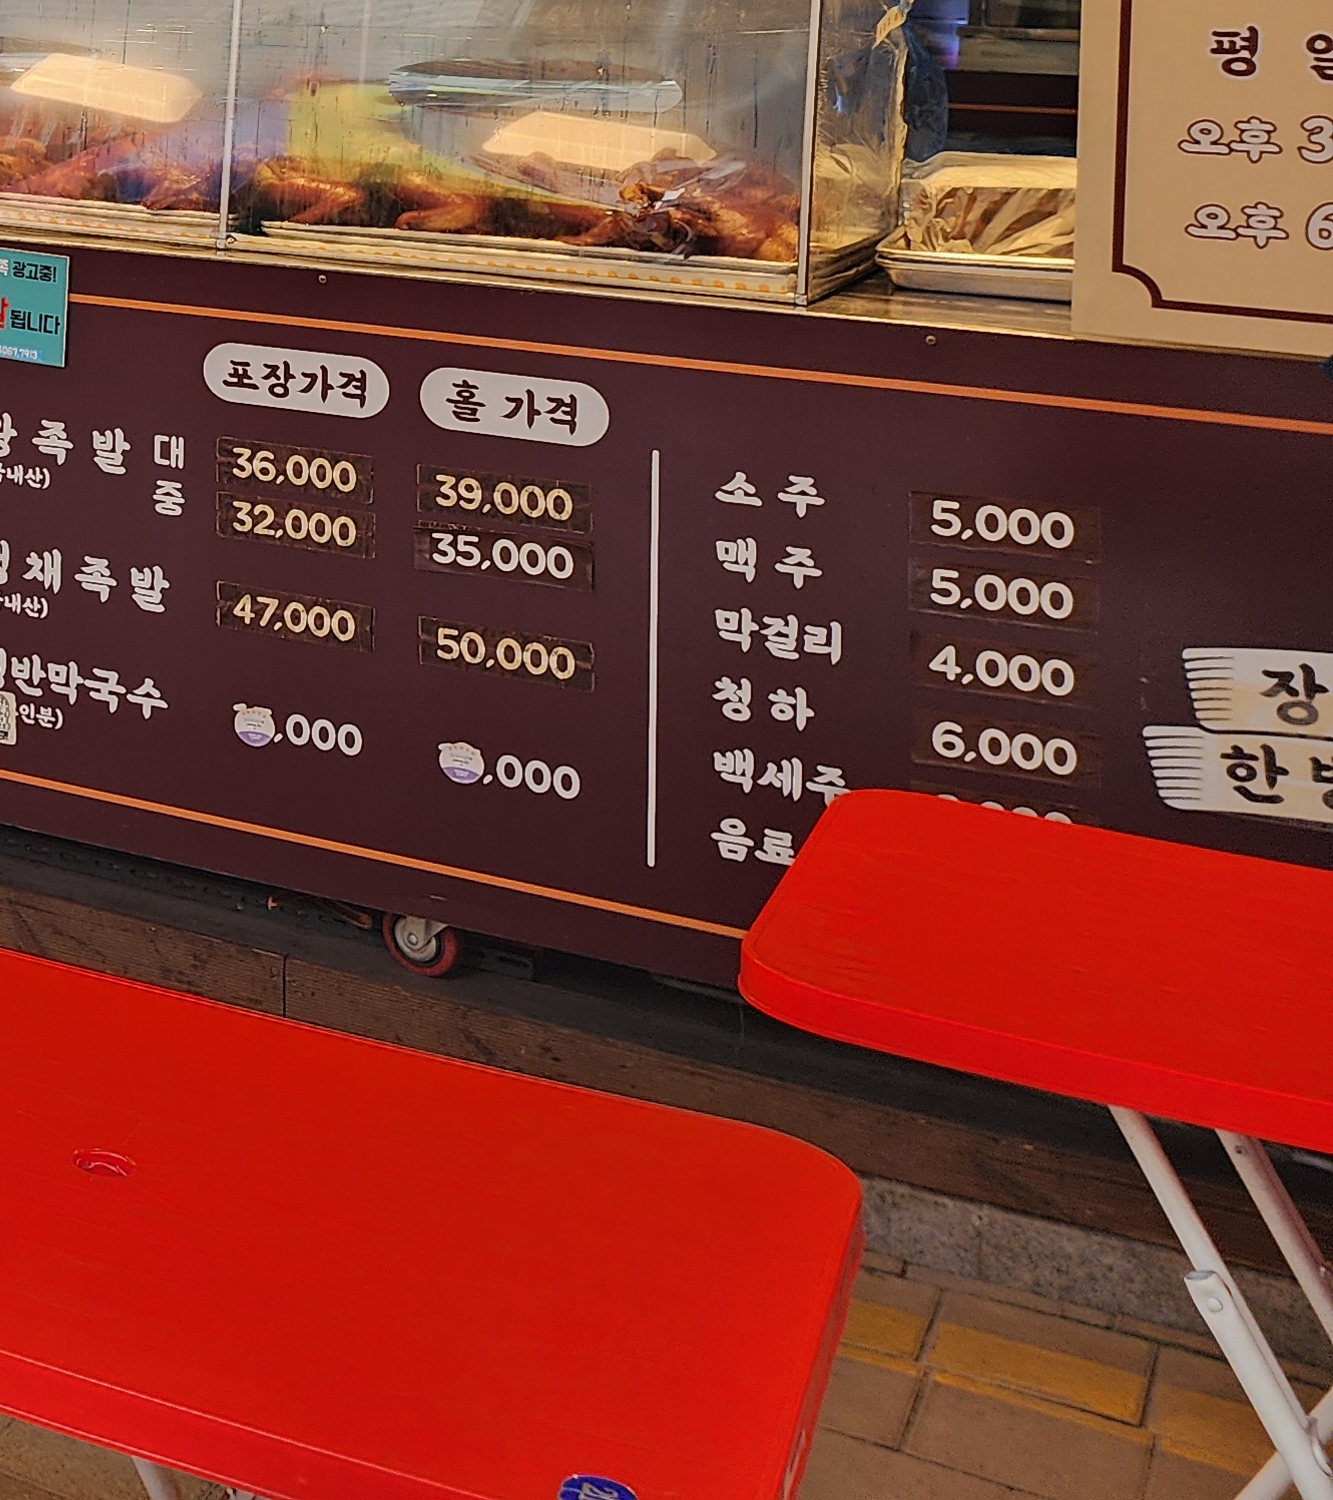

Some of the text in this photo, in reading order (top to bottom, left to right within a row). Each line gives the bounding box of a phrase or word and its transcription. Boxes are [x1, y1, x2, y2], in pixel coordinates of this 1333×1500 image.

[1177, 116, 1284, 164] 오후
[1184, 201, 1290, 250] 오후
[12, 261, 58, 283] 광고중!
[10, 309, 61, 335] 됩니다
[221, 359, 370, 410] 포장가격
[445, 379, 580, 437] 홀 가격
[153, 434, 186, 471] 대
[231, 446, 358, 494] 36,000
[434, 473, 574, 522] 39,000
[152, 479, 186, 517] 중
[231, 500, 358, 548] 32,000
[431, 531, 575, 581] 35,000
[931, 499, 1075, 550] 5,000
[929, 568, 1075, 621] 5,000
[232, 593, 357, 643] 47,000
[435, 627, 577, 681] 50,000
[714, 607, 1076, 698] 막걸리 4,000
[931, 720, 1078, 776] 6,000
[711, 748, 852, 804] 백세주
